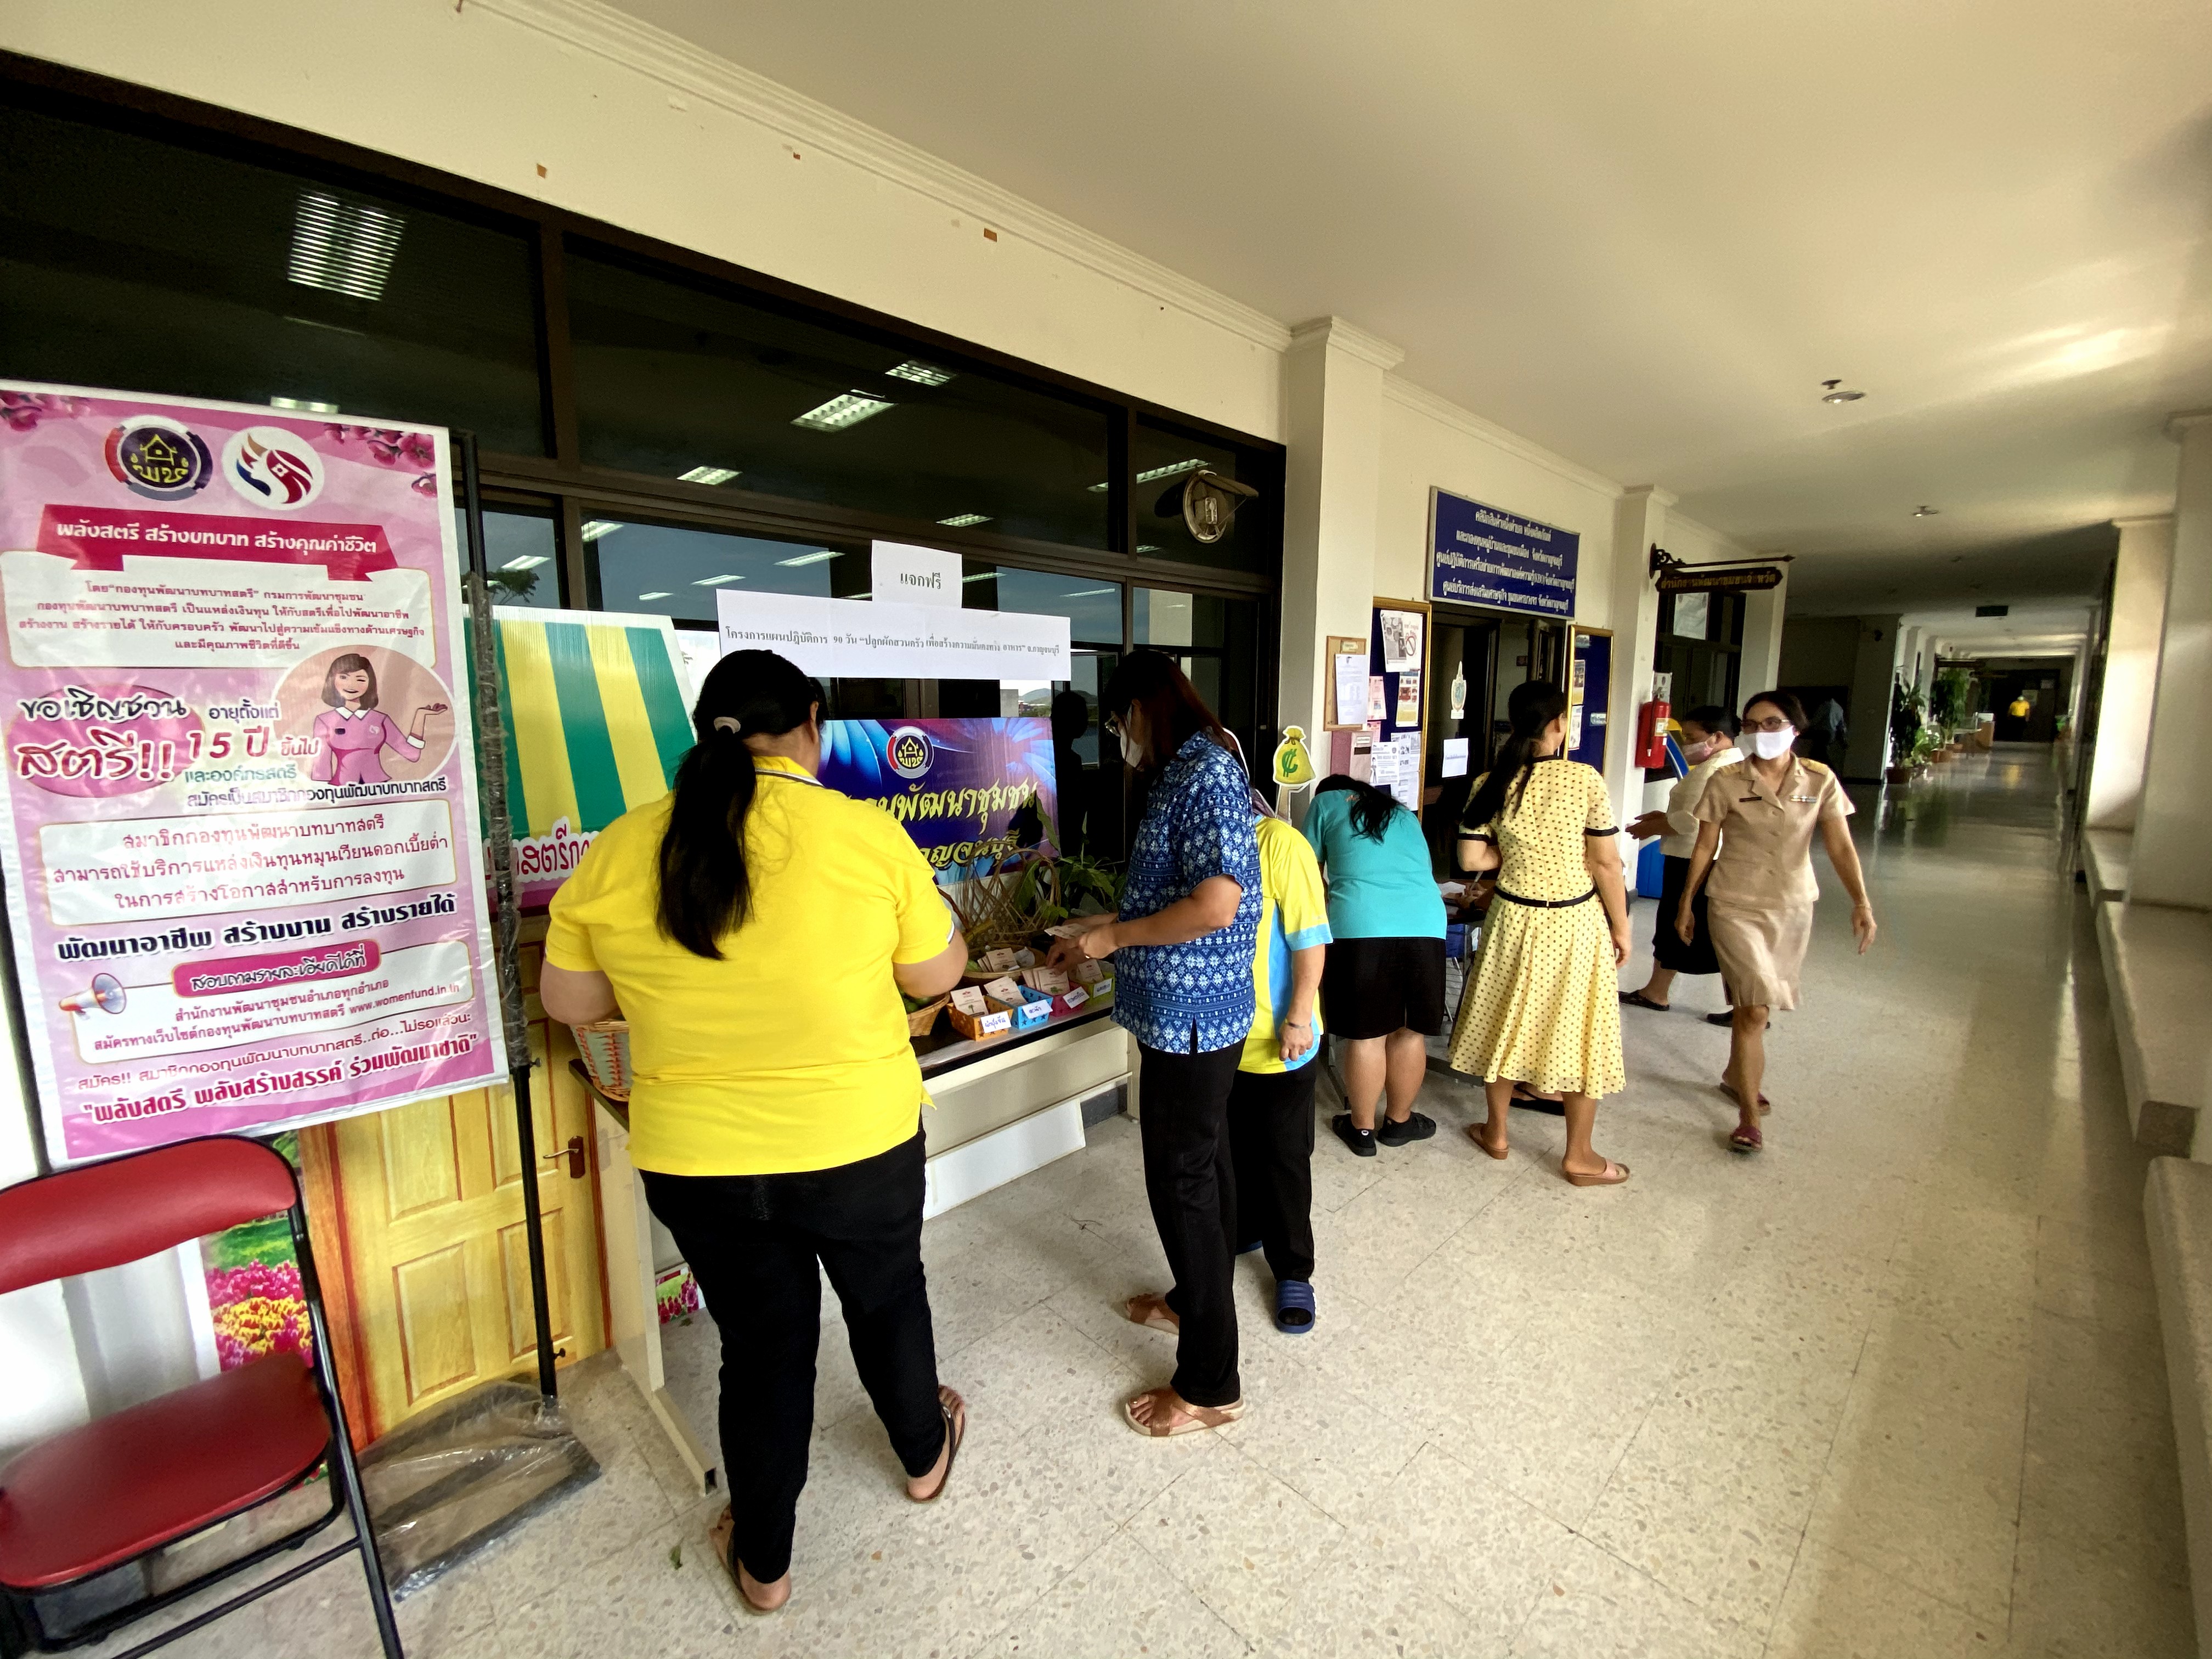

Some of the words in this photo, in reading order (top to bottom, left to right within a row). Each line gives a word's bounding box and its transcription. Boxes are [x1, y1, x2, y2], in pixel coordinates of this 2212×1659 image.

[57, 518, 140, 540] พลังสตรี
[145, 523, 249, 548] สร้างบทบาท
[255, 531, 377, 557] สร้างคุณค่าชีวิต
[264, 590, 363, 603] กรมการพัฒนาชุมชน
[900, 572, 941, 590] แจกฟรี
[19, 617, 68, 629] สร้างงาน
[72, 618, 136, 630] สร้างรายได้
[139, 618, 224, 632] ให้กับครอบครัว
[37, 600, 178, 613] กองทุนพัฒนาบทบาทสตรี
[182, 602, 269, 618] เป็นแหล่งเงินทุน
[175, 637, 300, 652] และมีคุณภาพชีวิตที่ดีขึ้น
[725, 625, 828, 645] โครงการแผนปฏิบัติการ
[833, 636, 843, 644] 90
[845, 633, 857, 644] วัน
[1028, 645, 1060, 656] จ.กาญจนบุรี
[20, 687, 187, 720] ขอเชิญชวน
[209, 699, 280, 724] อายุตั้งแต่
[18, 729, 172, 778] สตรี!!
[244, 725, 270, 757] ปี
[281, 737, 320, 756] ขึ้นไป
[185, 764, 297, 783] และองค์กรสตรี
[187, 777, 447, 807] สมัครเป็นสมาชิกกองทุนพัฒนาบทบาทสตรี
[849, 777, 1039, 834] นพัฒนาชุมชน
[122, 813, 385, 849] สมาชิกกองทุนพัฒนาบทบาทสตรี
[54, 832, 448, 883] สามารถใช้บริการแหล่งเงินทุนหมุนเวียนดอกเบี้ยต่ำ
[114, 868, 405, 909] ในการสร้างโอกาสสำหรับการลงทุน
[58, 927, 212, 960] พัฒนาอาชีพ
[224, 917, 330, 945] สร้างงาน
[342, 894, 455, 929] สร้างรายได้
[191, 943, 365, 991] สอบถามรายละเอียดได้ที่
[94, 1005, 345, 1050] สมัครทางเว็บไซต์กองทุนพัฒนาบทบาทสตรี
[349, 983, 460, 1014] www.womenfund.inth
[175, 979, 389, 1022] สำนักงานพัฒนาชุมชนอำเภอทุกอำเภอ
[78, 1073, 131, 1090] สมัคร!!
[83, 1088, 186, 1122] "พลังสตรี
[195, 1060, 342, 1104] พลังสร้างสรรค์
[350, 1033, 477, 1077] ร่วมพัฒนาชาติ"
